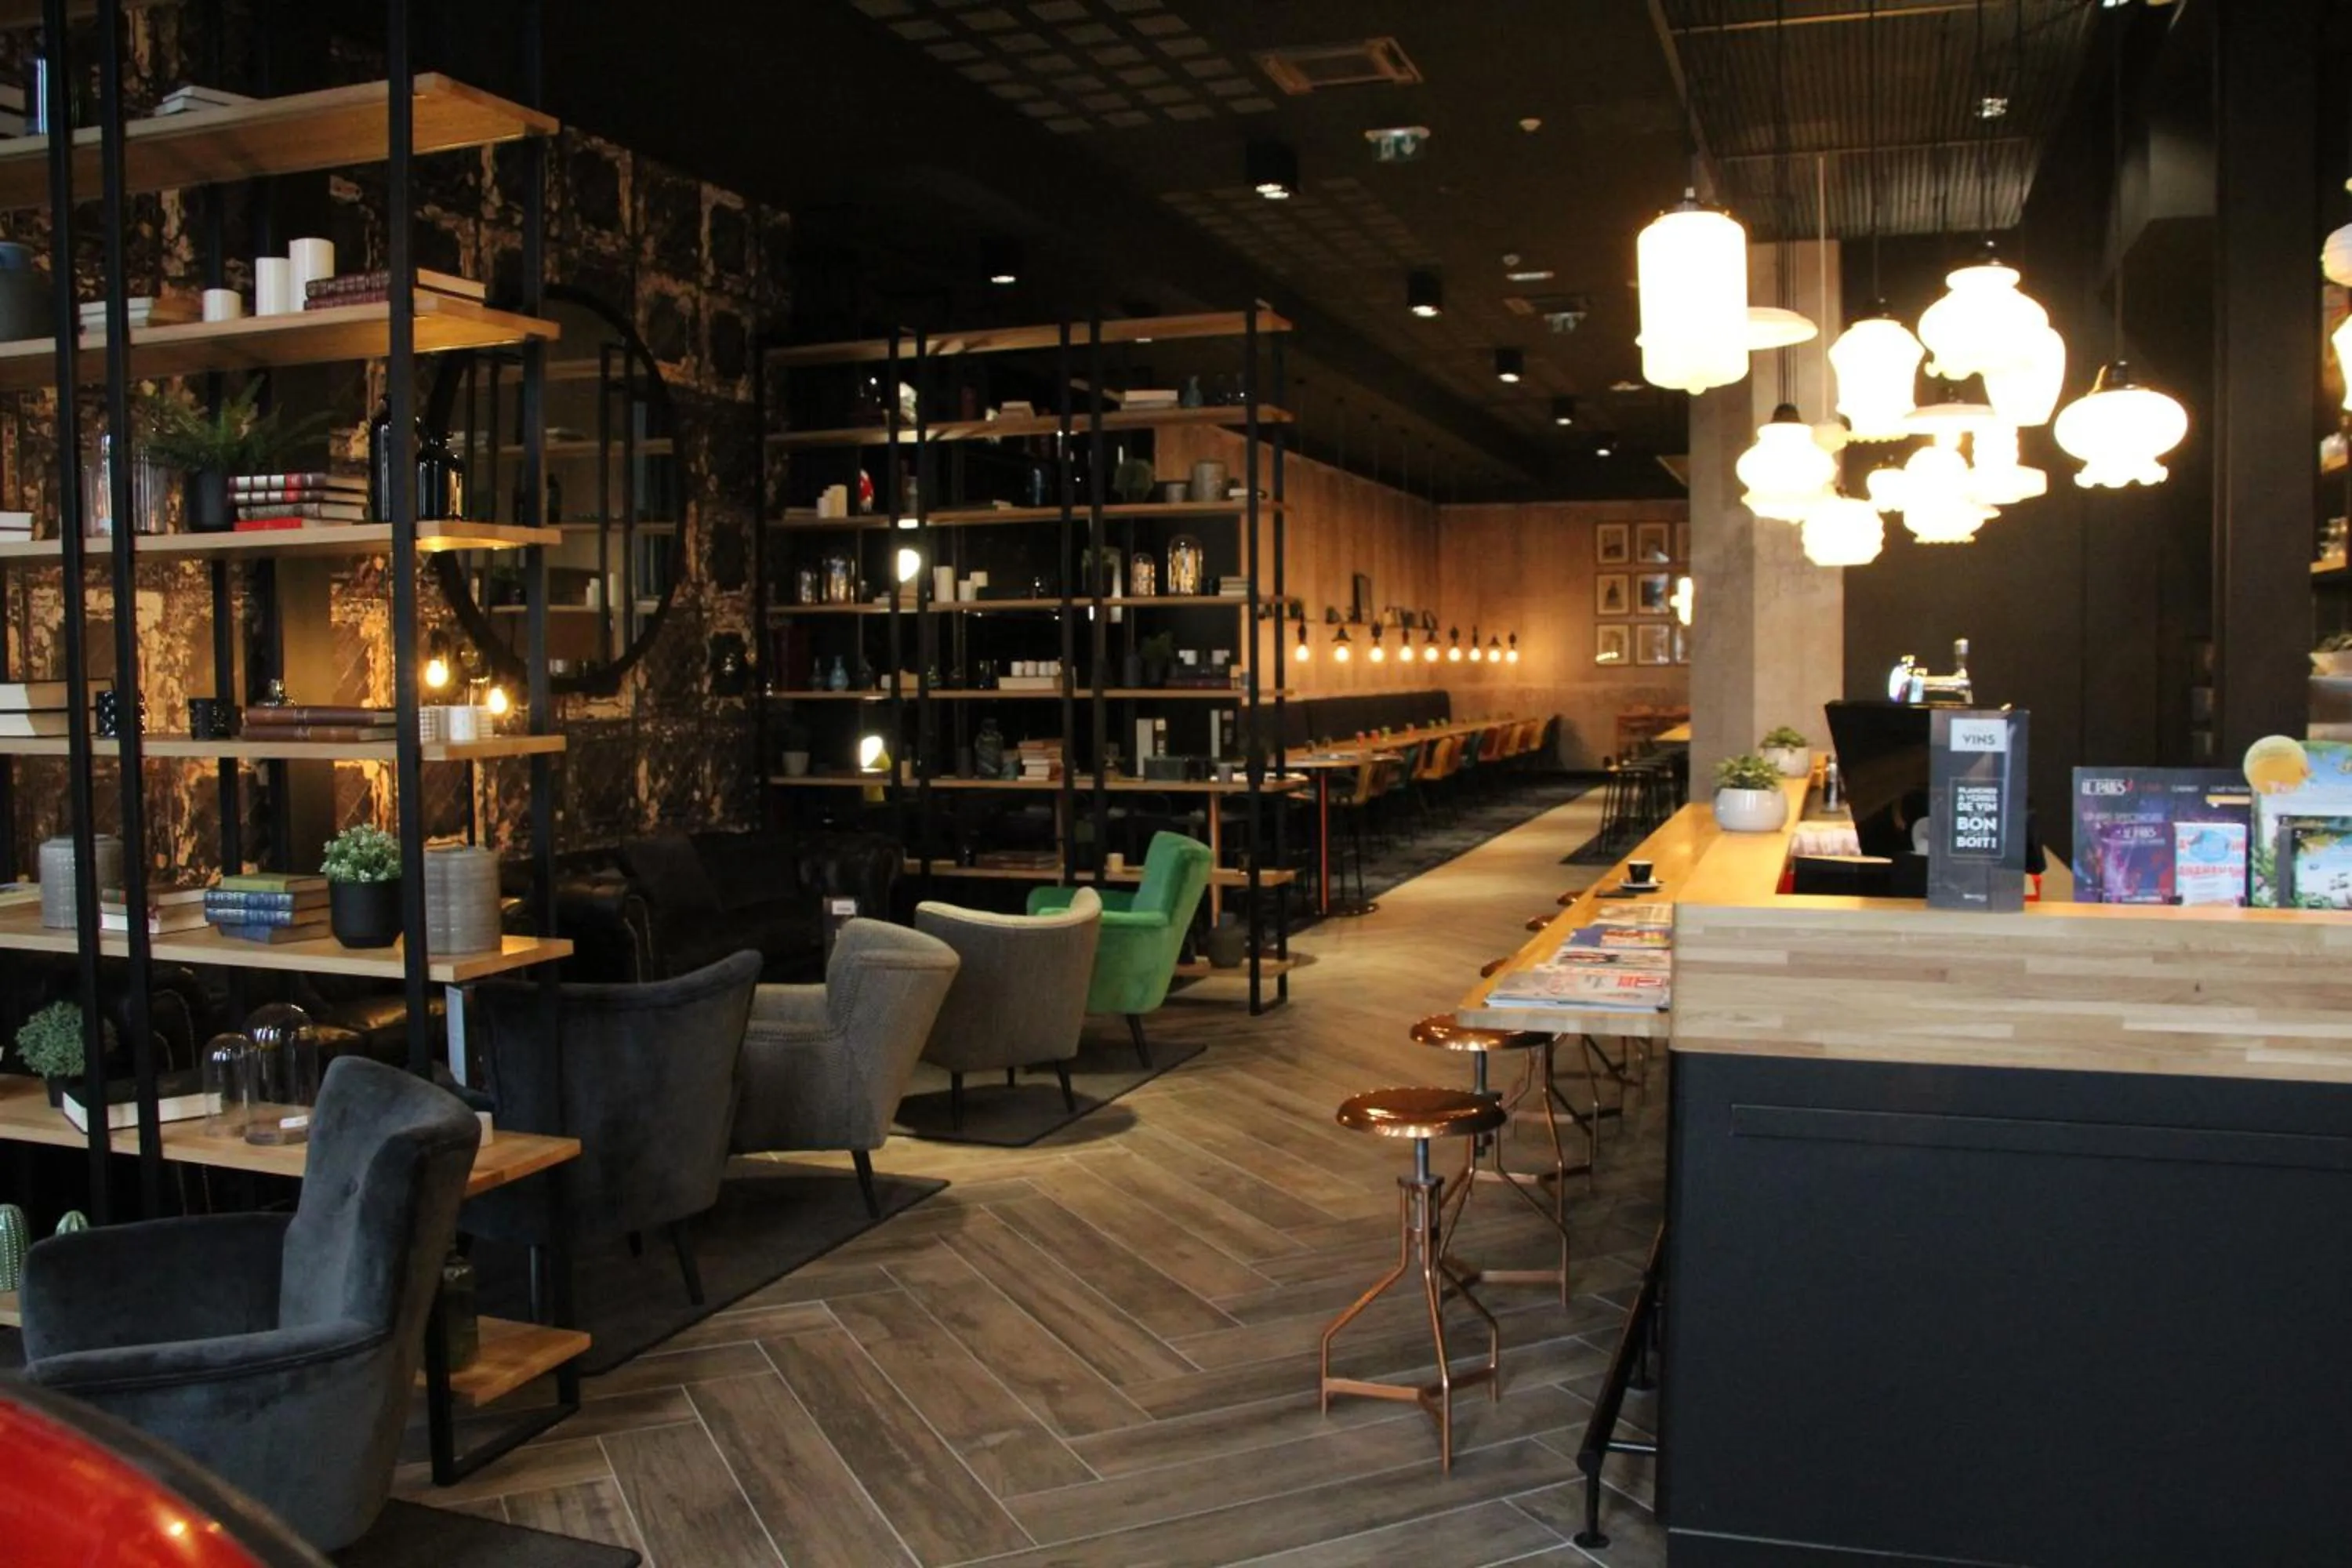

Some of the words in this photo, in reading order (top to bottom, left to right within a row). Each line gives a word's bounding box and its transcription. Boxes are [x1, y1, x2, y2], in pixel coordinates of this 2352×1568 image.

[1962, 734, 1996, 745] VINS
[1957, 802, 1973, 811] DE
[1976, 802, 1998, 811] VIN
[1956, 817, 1997, 830] BON
